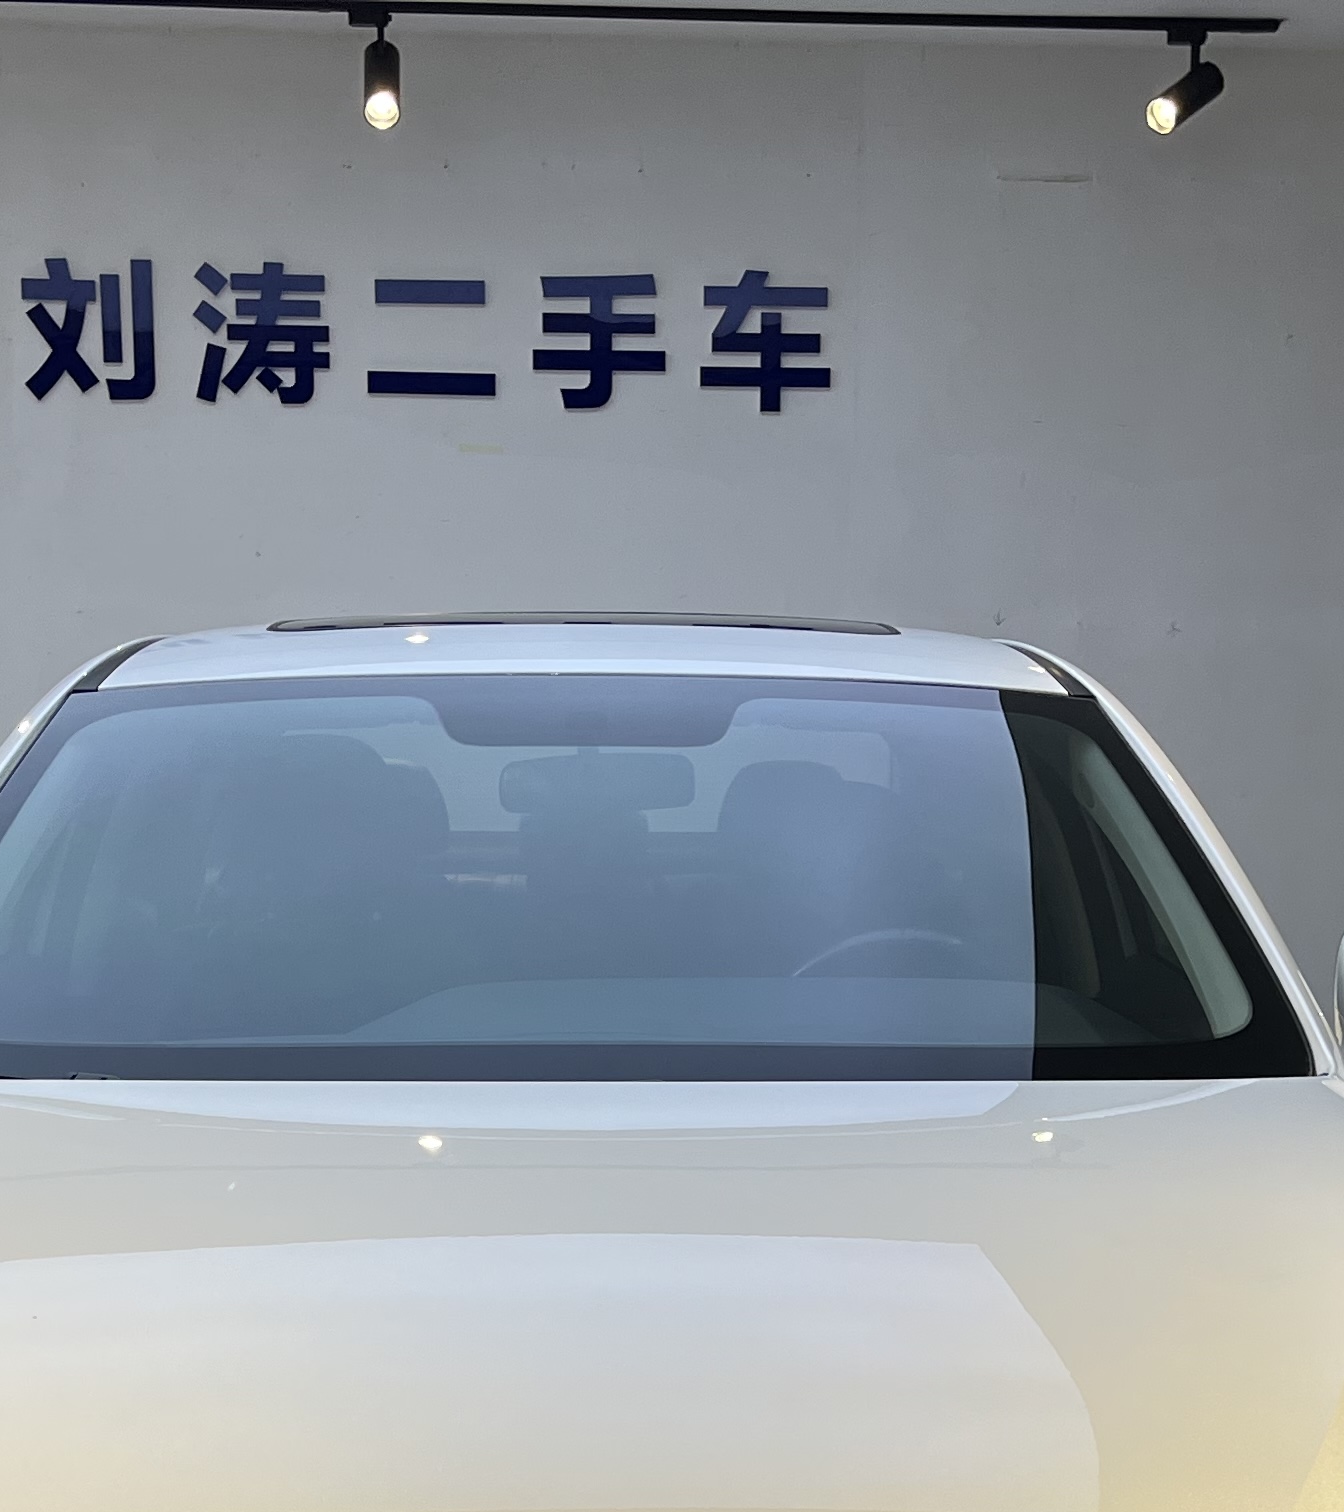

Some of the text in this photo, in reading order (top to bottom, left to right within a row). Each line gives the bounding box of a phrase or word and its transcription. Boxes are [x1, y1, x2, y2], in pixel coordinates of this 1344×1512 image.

[19, 256, 832, 414] 刘涛二手车
